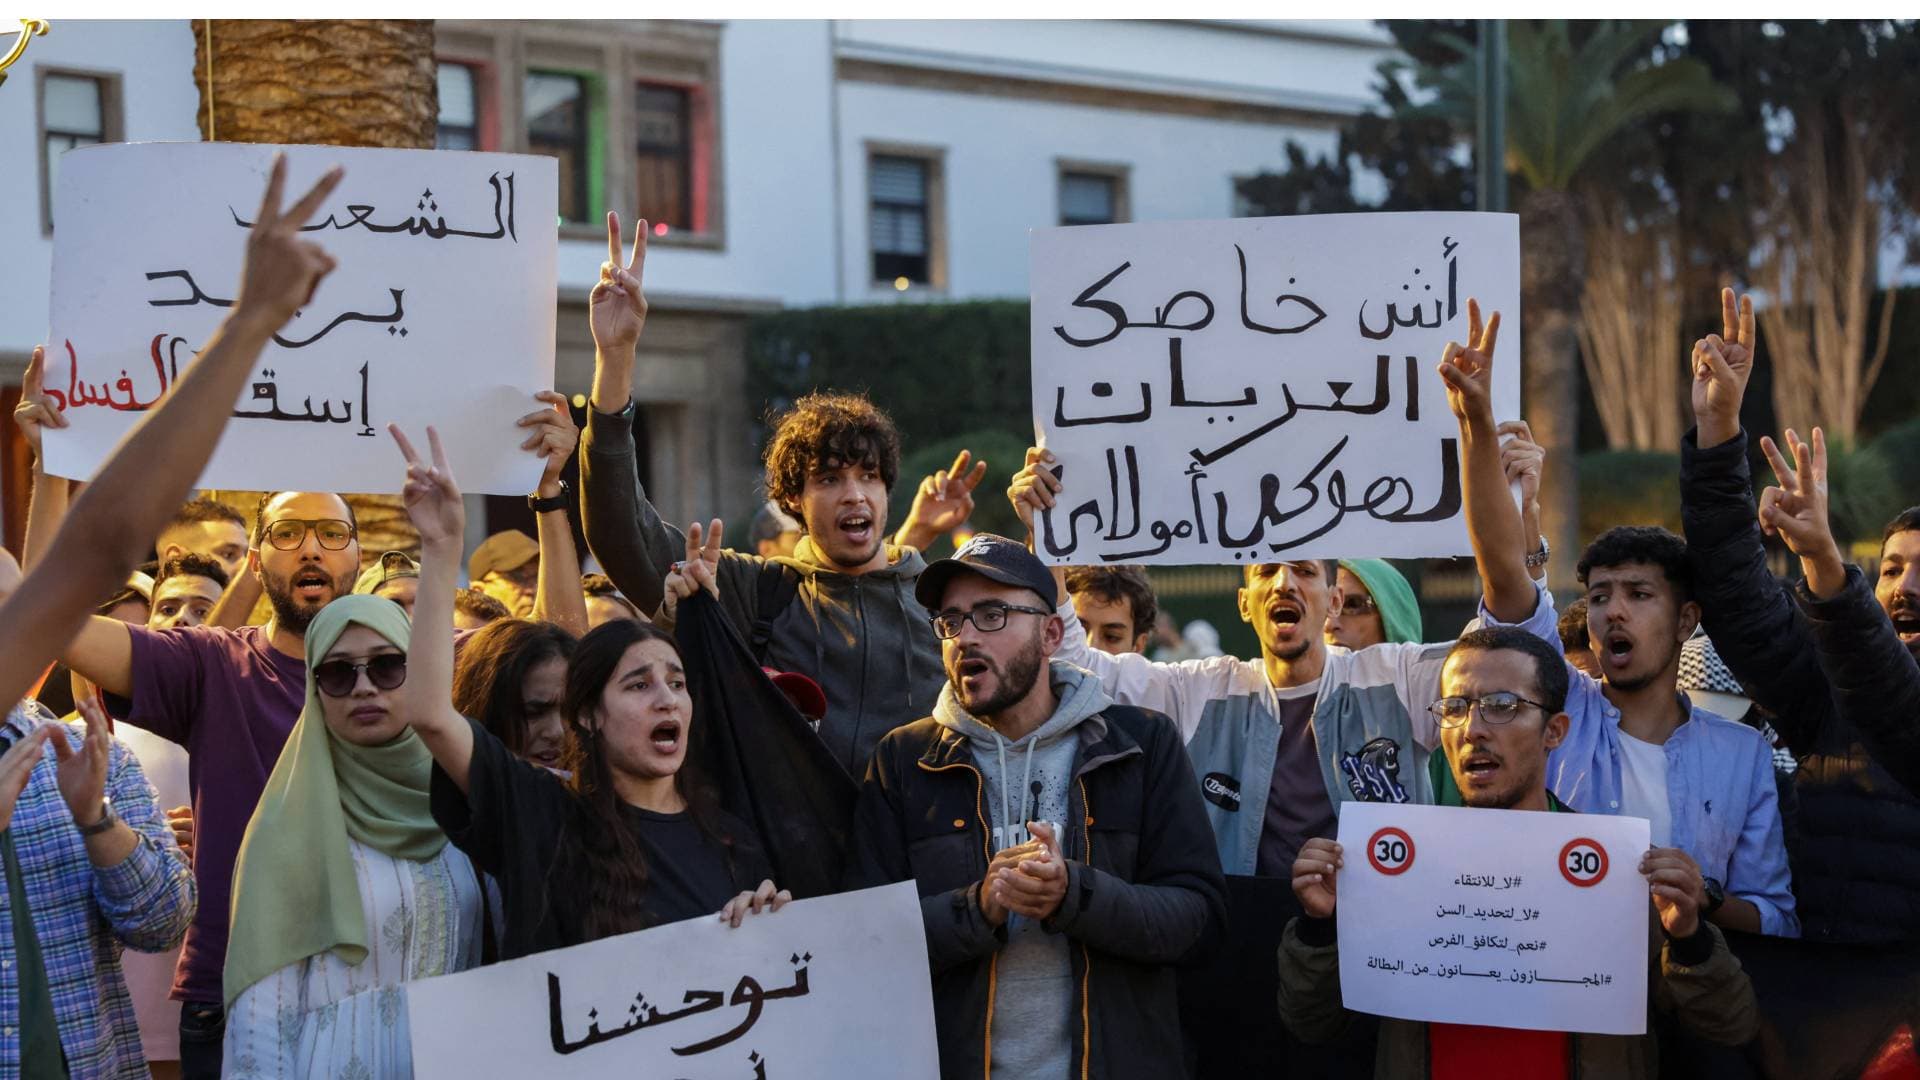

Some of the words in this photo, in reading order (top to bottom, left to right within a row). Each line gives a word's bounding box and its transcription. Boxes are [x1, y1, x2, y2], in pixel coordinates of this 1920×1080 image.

[1054, 337, 1419, 466] العريان
[1376, 840, 1407, 863] 30
[1568, 851, 1600, 874] 30
[547, 951, 812, 1056] توحشنا
